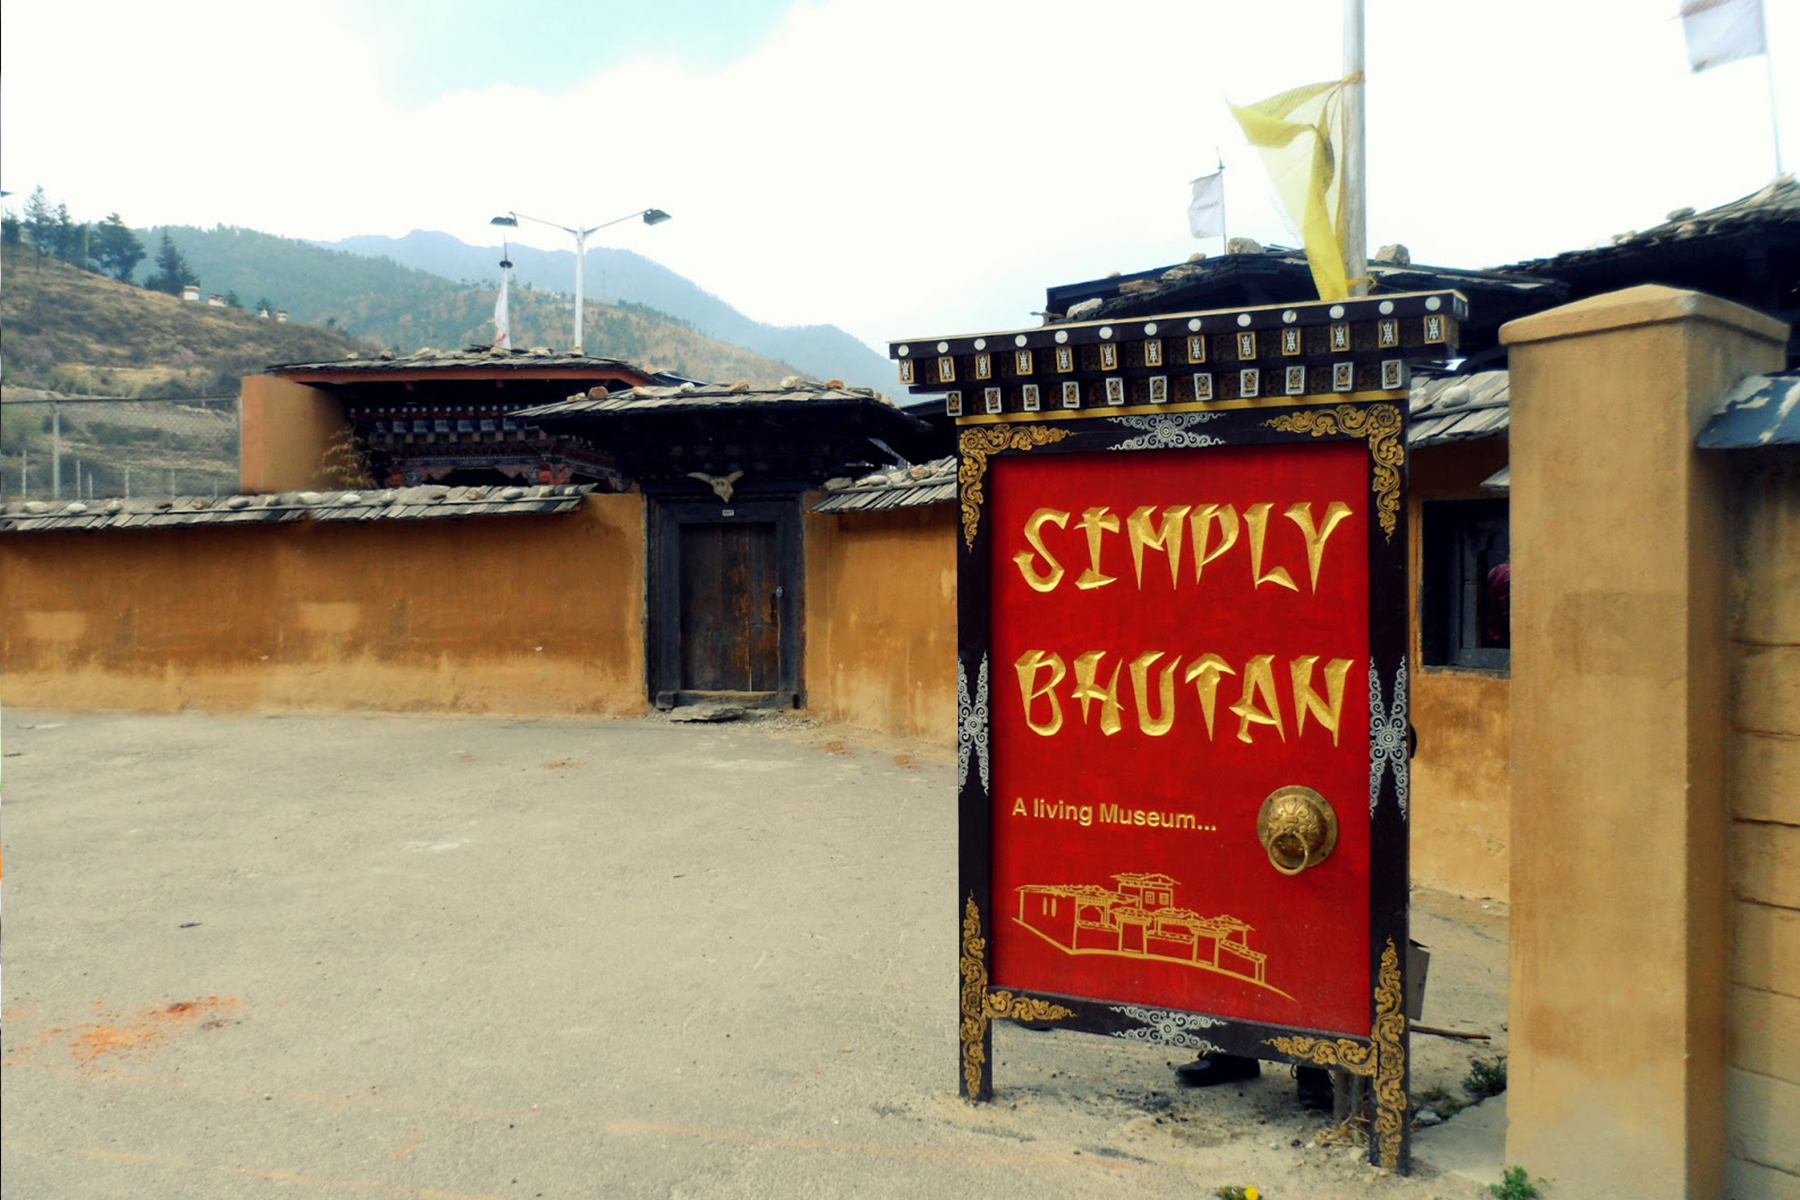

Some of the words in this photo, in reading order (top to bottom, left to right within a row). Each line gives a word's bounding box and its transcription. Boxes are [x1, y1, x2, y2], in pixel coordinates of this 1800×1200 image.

[1013, 502, 1353, 595] SIMPLY
[1014, 649, 1354, 747] BHUTAN
[1012, 797, 1028, 816] A
[1033, 798, 1093, 826] living
[1099, 803, 1217, 831] Museum...
